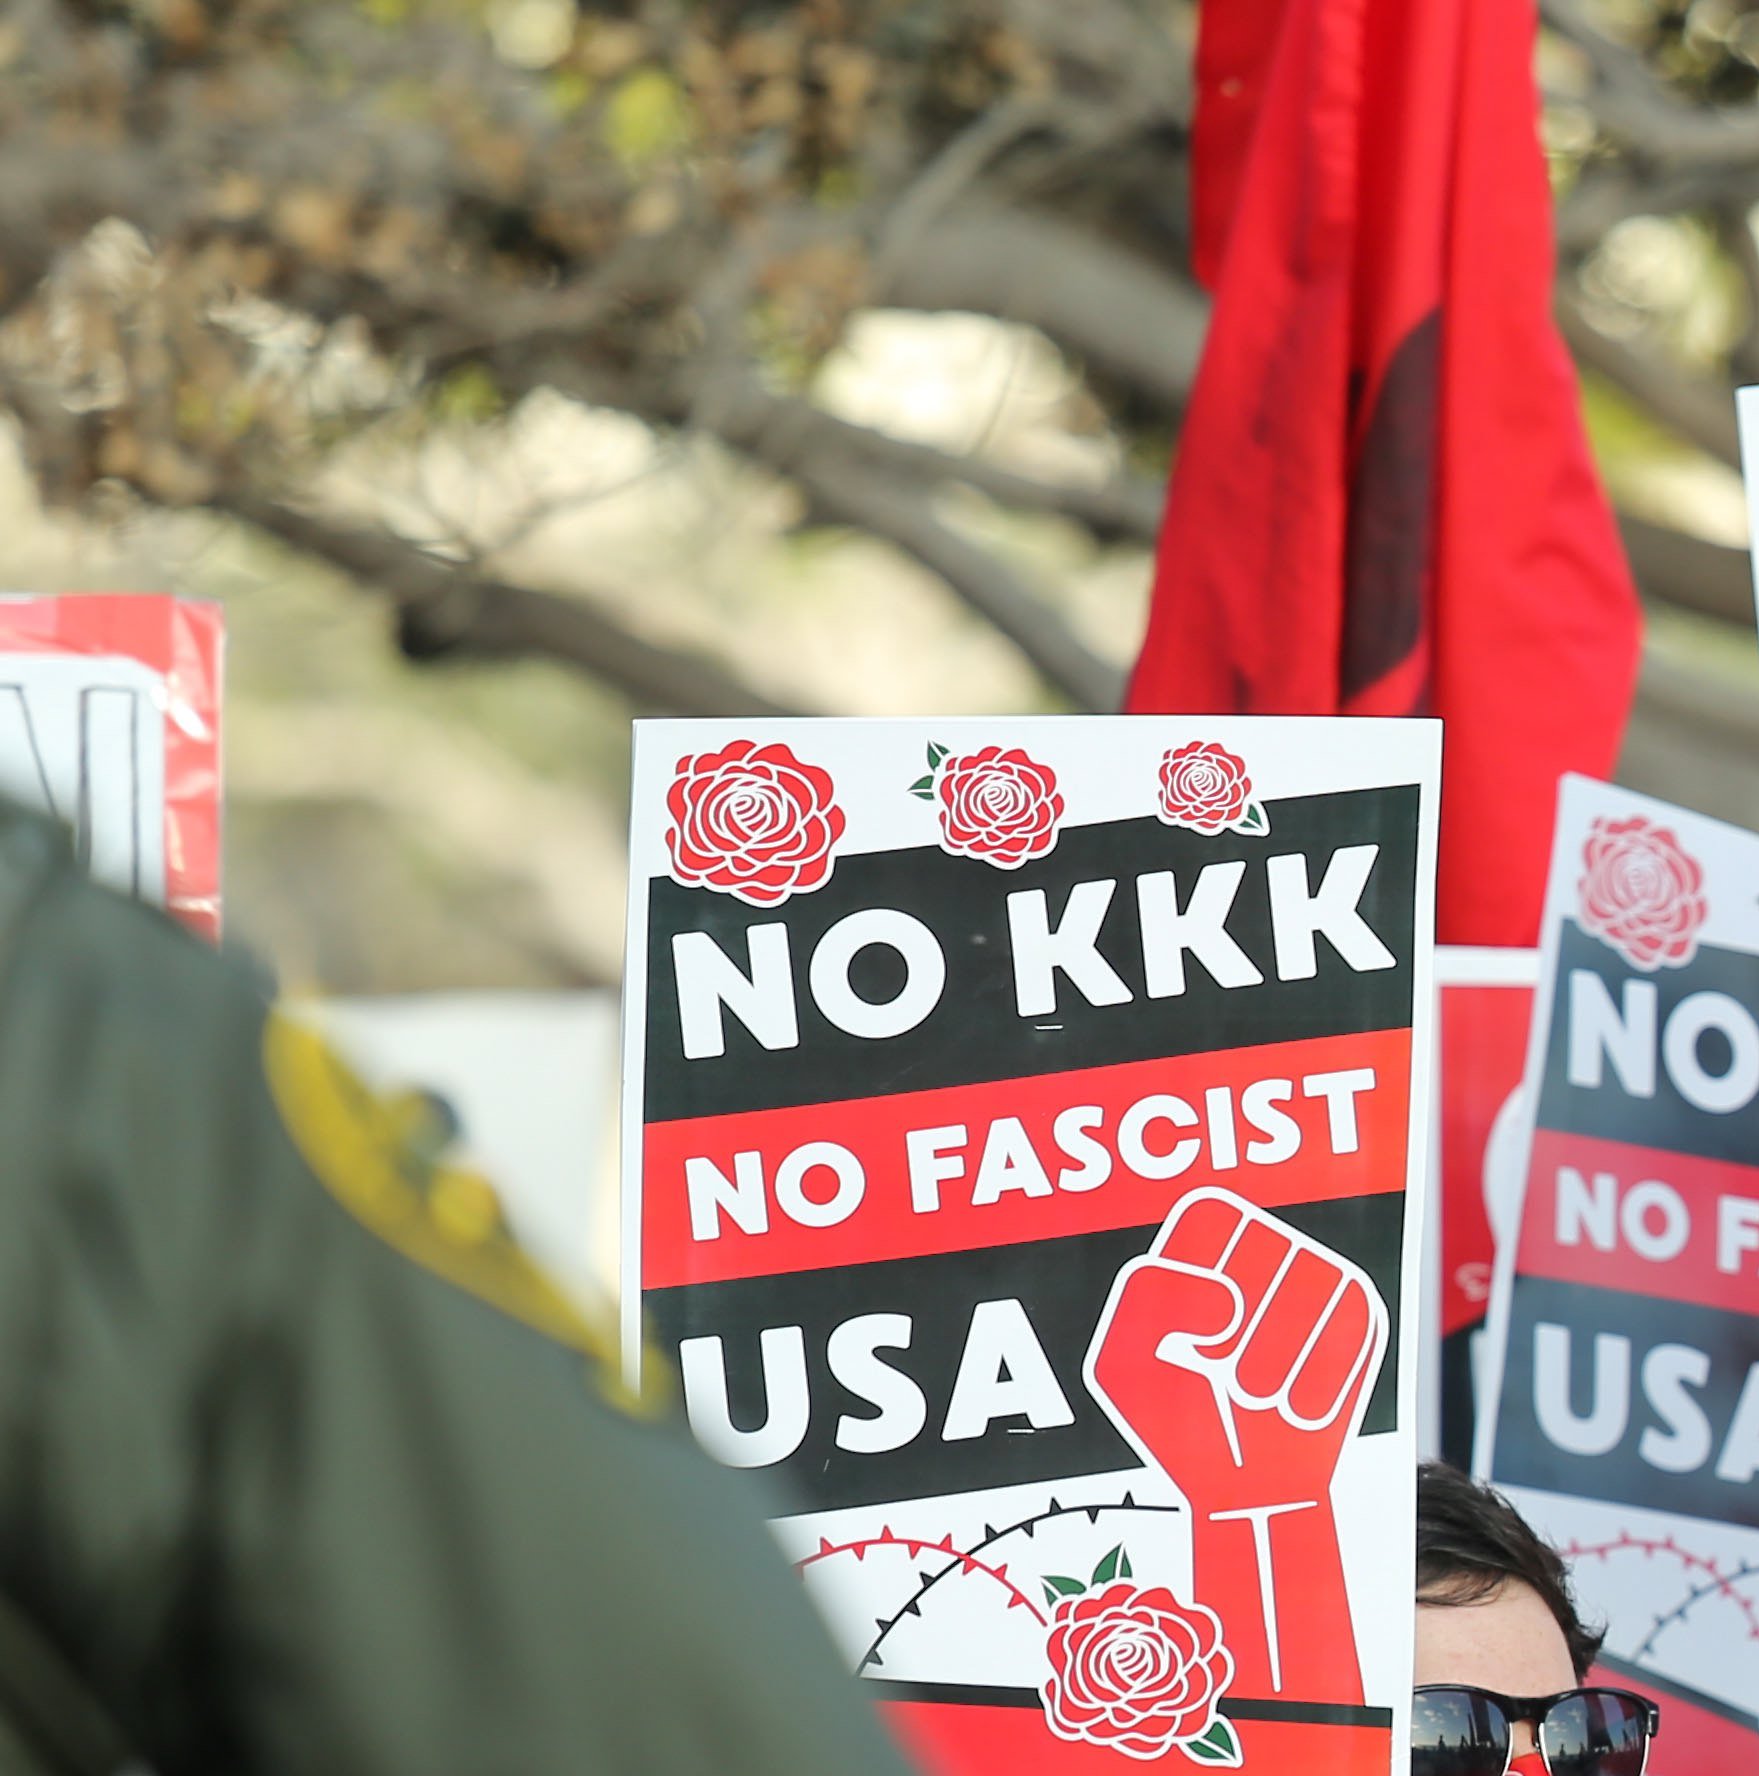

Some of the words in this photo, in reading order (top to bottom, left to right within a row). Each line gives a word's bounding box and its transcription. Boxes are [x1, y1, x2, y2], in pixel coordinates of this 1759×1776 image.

[671, 907, 948, 1060] NO
[1006, 843, 1398, 1018] KKK
[685, 1140, 867, 1242] NO
[905, 1066, 1376, 1214] FASCIST
[1553, 1166, 1691, 1262] NO
[678, 1298, 1077, 1470] USA
